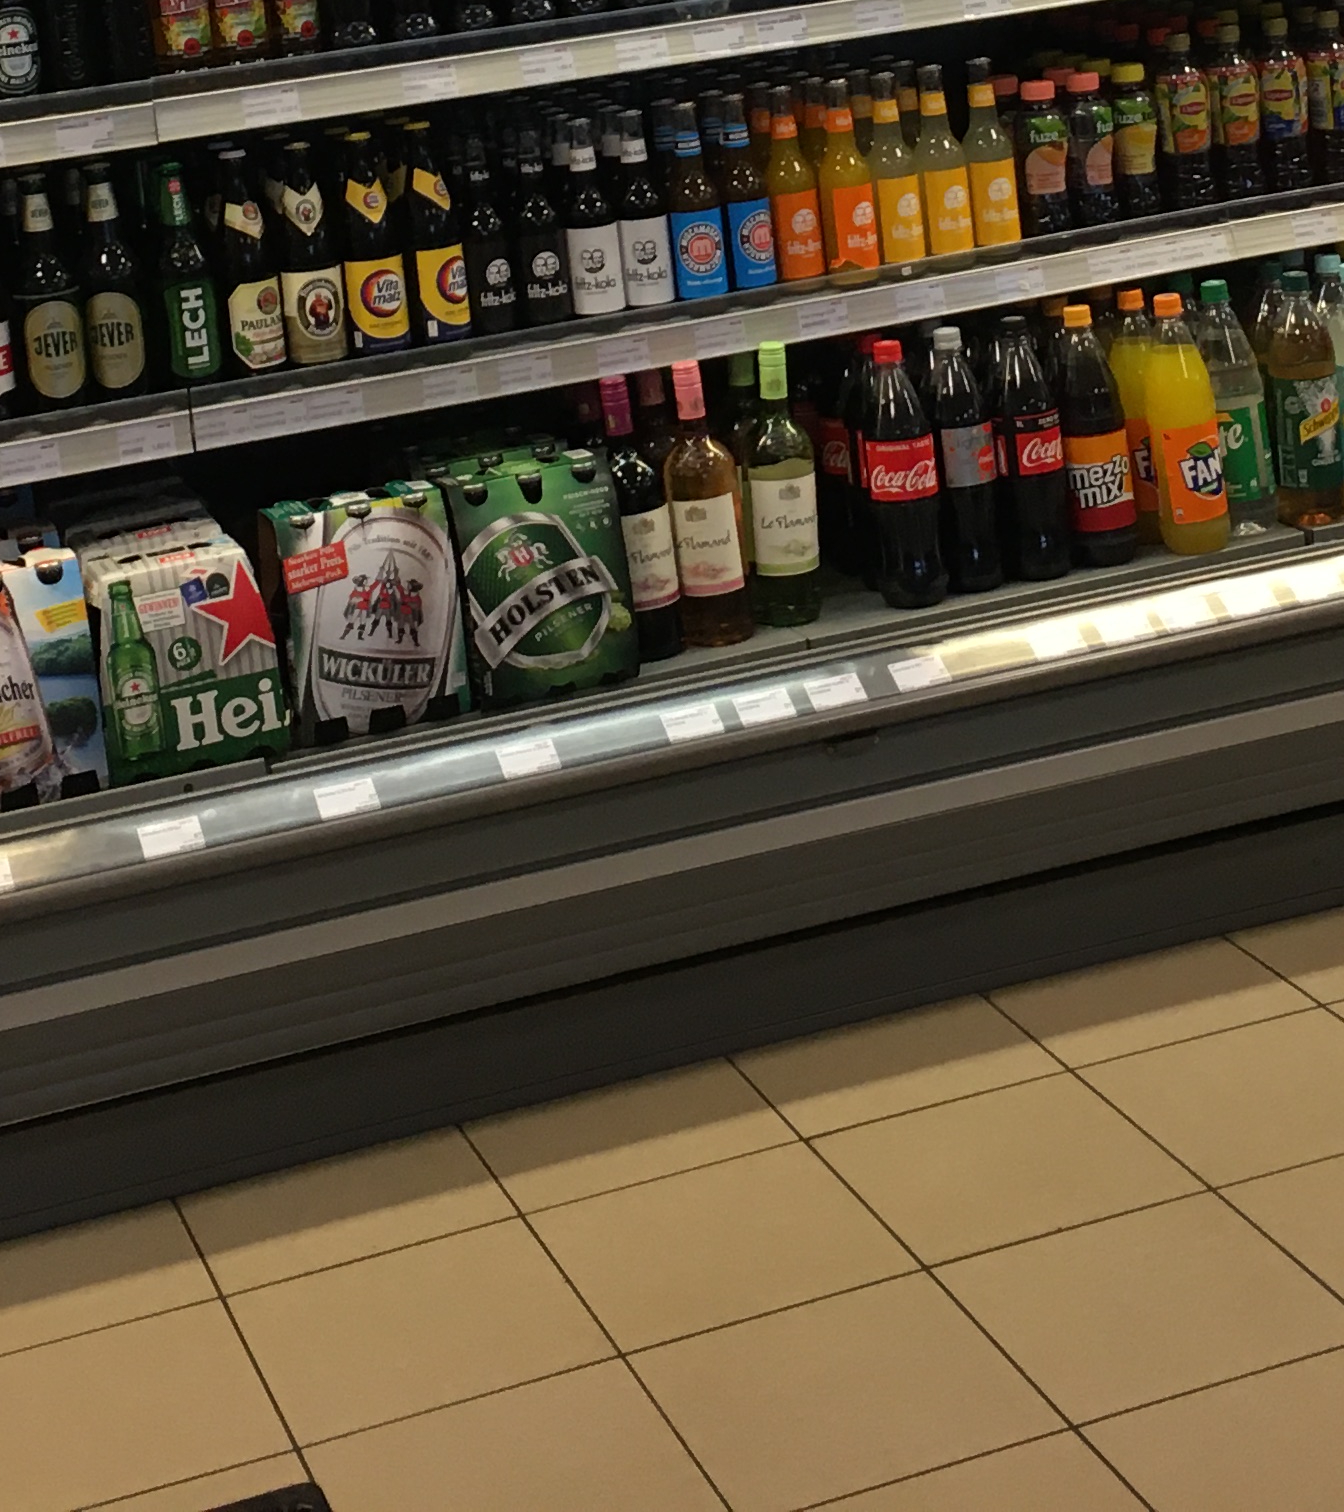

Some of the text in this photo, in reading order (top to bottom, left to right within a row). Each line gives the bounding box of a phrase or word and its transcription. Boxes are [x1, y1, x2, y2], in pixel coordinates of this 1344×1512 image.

[1114, 110, 1143, 124] fuze
[1030, 129, 1059, 145] fuze
[371, 290, 403, 304] malz
[376, 279, 400, 295] Vita
[186, 287, 209, 371] LECH
[34, 331, 78, 357] JEVER
[870, 461, 936, 493] Coca-Cola
[1068, 456, 1129, 484] mezzo
[1079, 481, 1123, 507] mix
[492, 562, 600, 646] HOLSTEN
[534, 602, 593, 642] PILSENER
[320, 653, 432, 686] WICKÜLER
[342, 688, 405, 702] PILSENER
